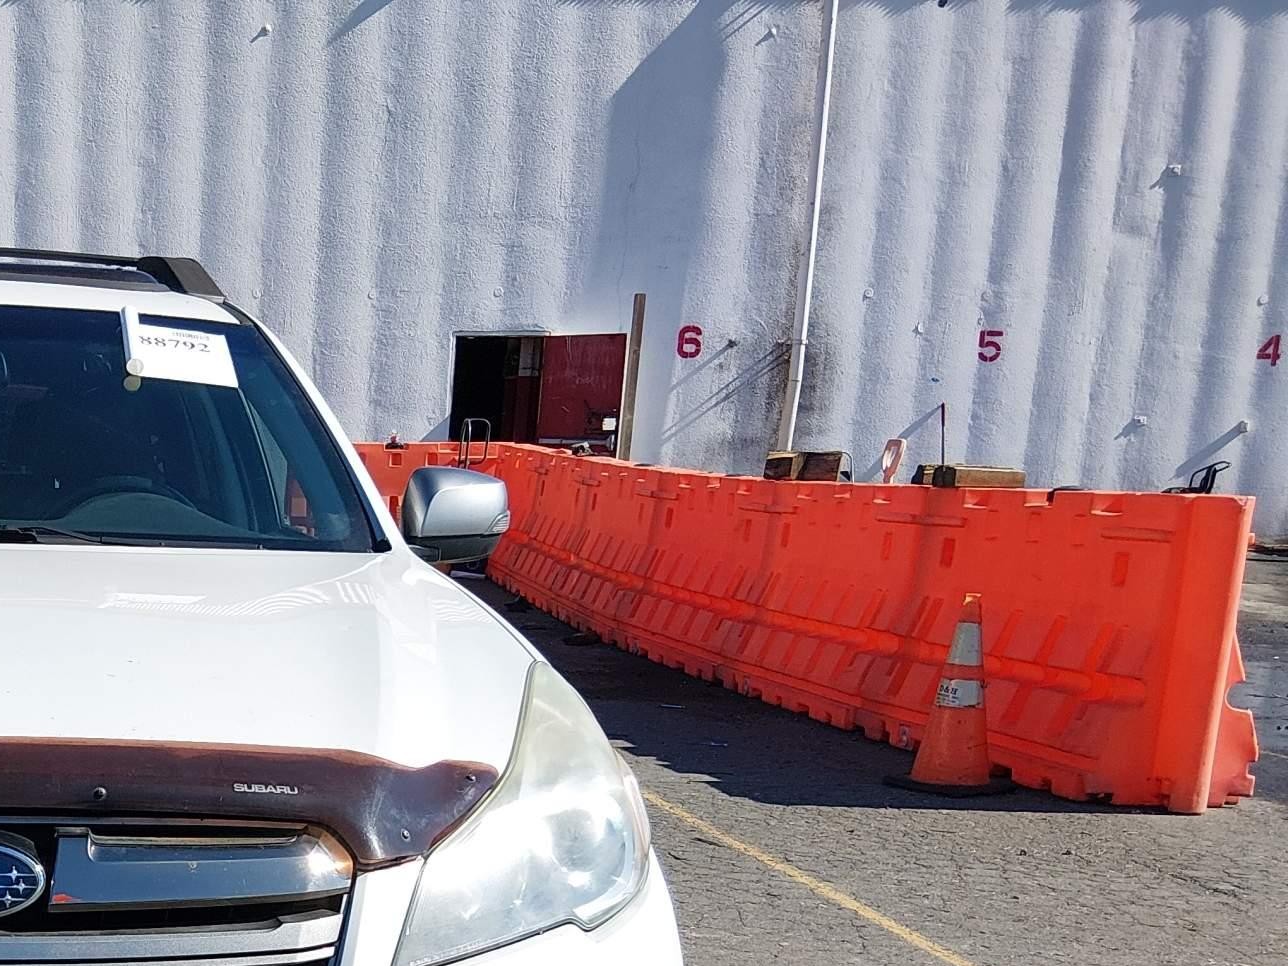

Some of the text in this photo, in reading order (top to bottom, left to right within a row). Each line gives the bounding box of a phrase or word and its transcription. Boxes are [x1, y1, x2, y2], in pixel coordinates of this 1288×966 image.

[138, 335, 211, 353] 88792
[676, 324, 702, 358] 6
[978, 331, 1003, 362] 5
[1255, 334, 1282, 367] 4
[233, 783, 299, 795] SUBARU
